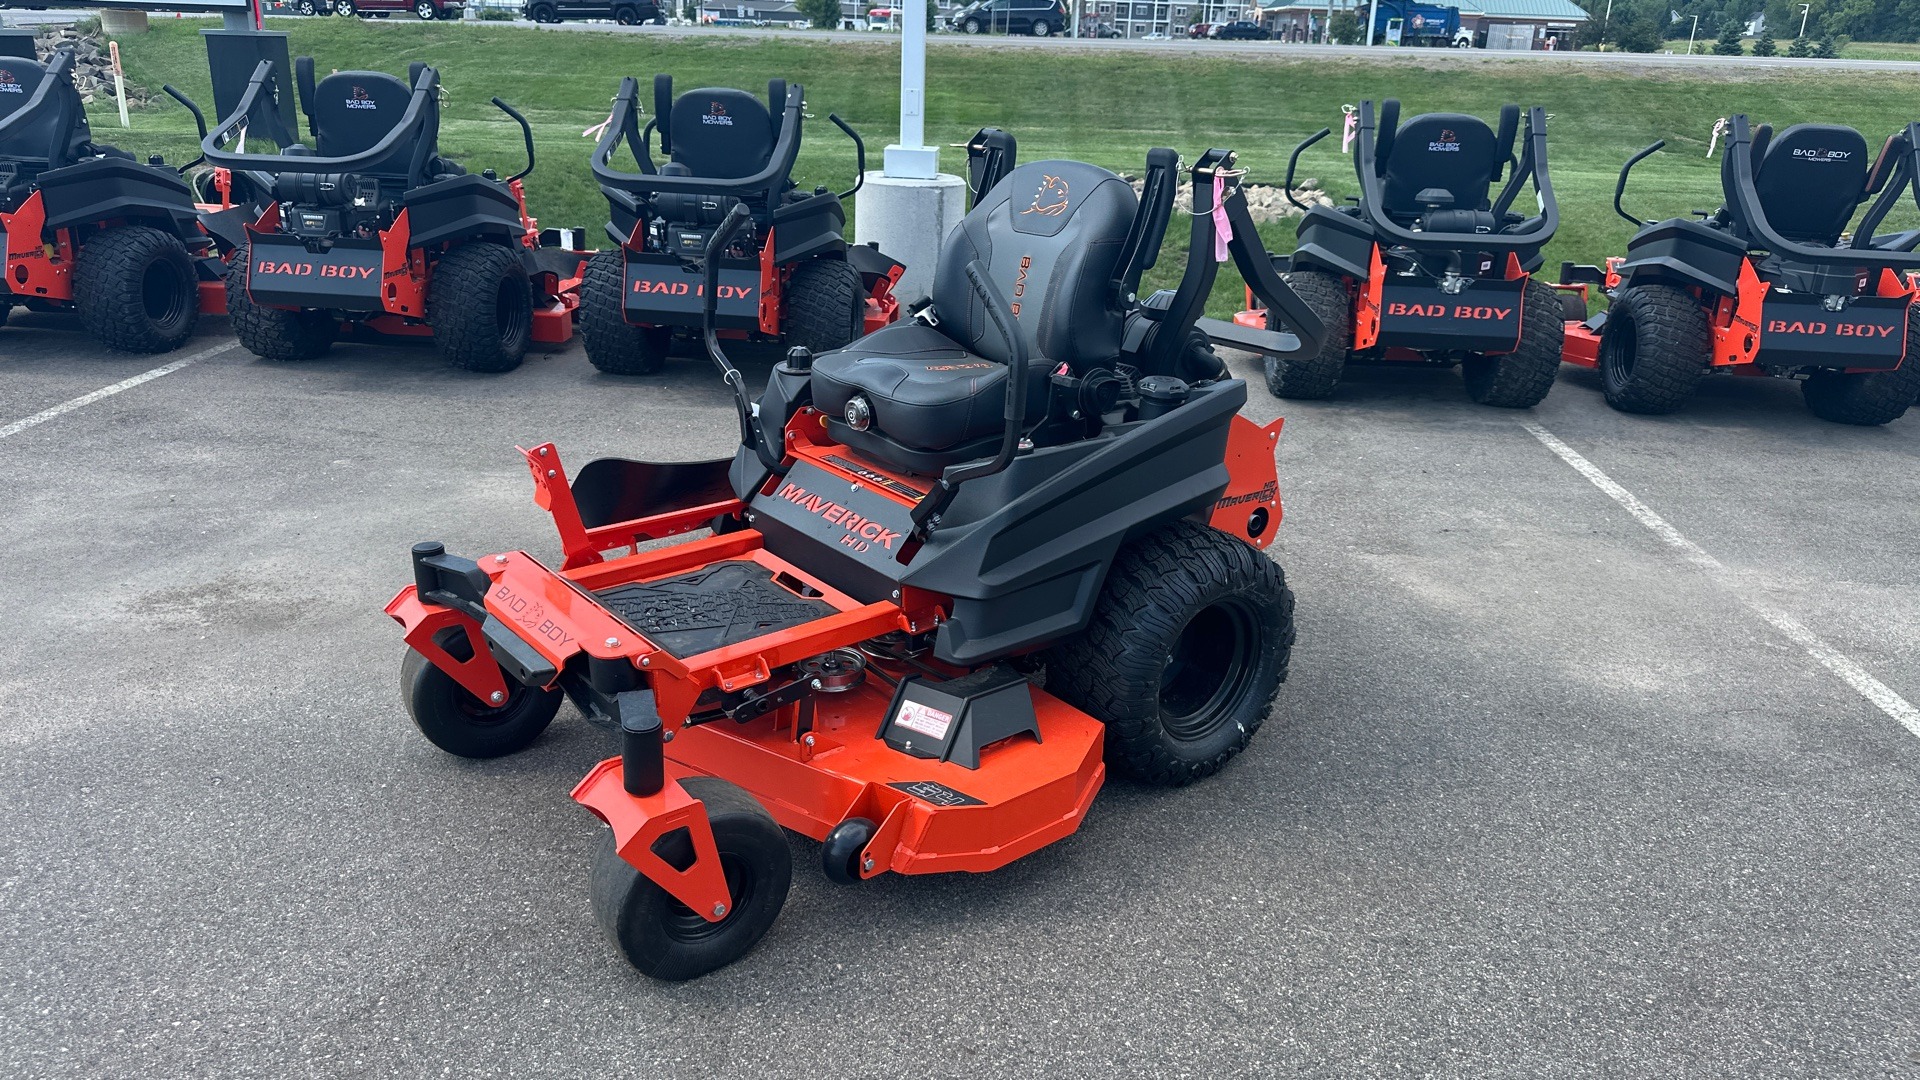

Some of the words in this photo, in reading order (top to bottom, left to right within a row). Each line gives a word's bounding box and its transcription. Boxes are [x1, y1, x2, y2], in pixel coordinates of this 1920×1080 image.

[1792, 148, 1816, 157] BAD
[258, 261, 313, 276] BAD
[320, 264, 375, 279] BOY
[1014, 256, 1031, 298] BAD
[633, 280, 689, 295] BAD
[1388, 303, 1446, 317] BAD
[1453, 306, 1512, 320] BOY
[1768, 320, 1827, 335] BAD
[1835, 323, 1895, 338] BOY
[778, 482, 902, 550] MAVERICK
[840, 534, 870, 553] HD
[495, 586, 527, 613] BAD
[538, 619, 575, 647] BOY
[926, 709, 950, 722] DANGER
